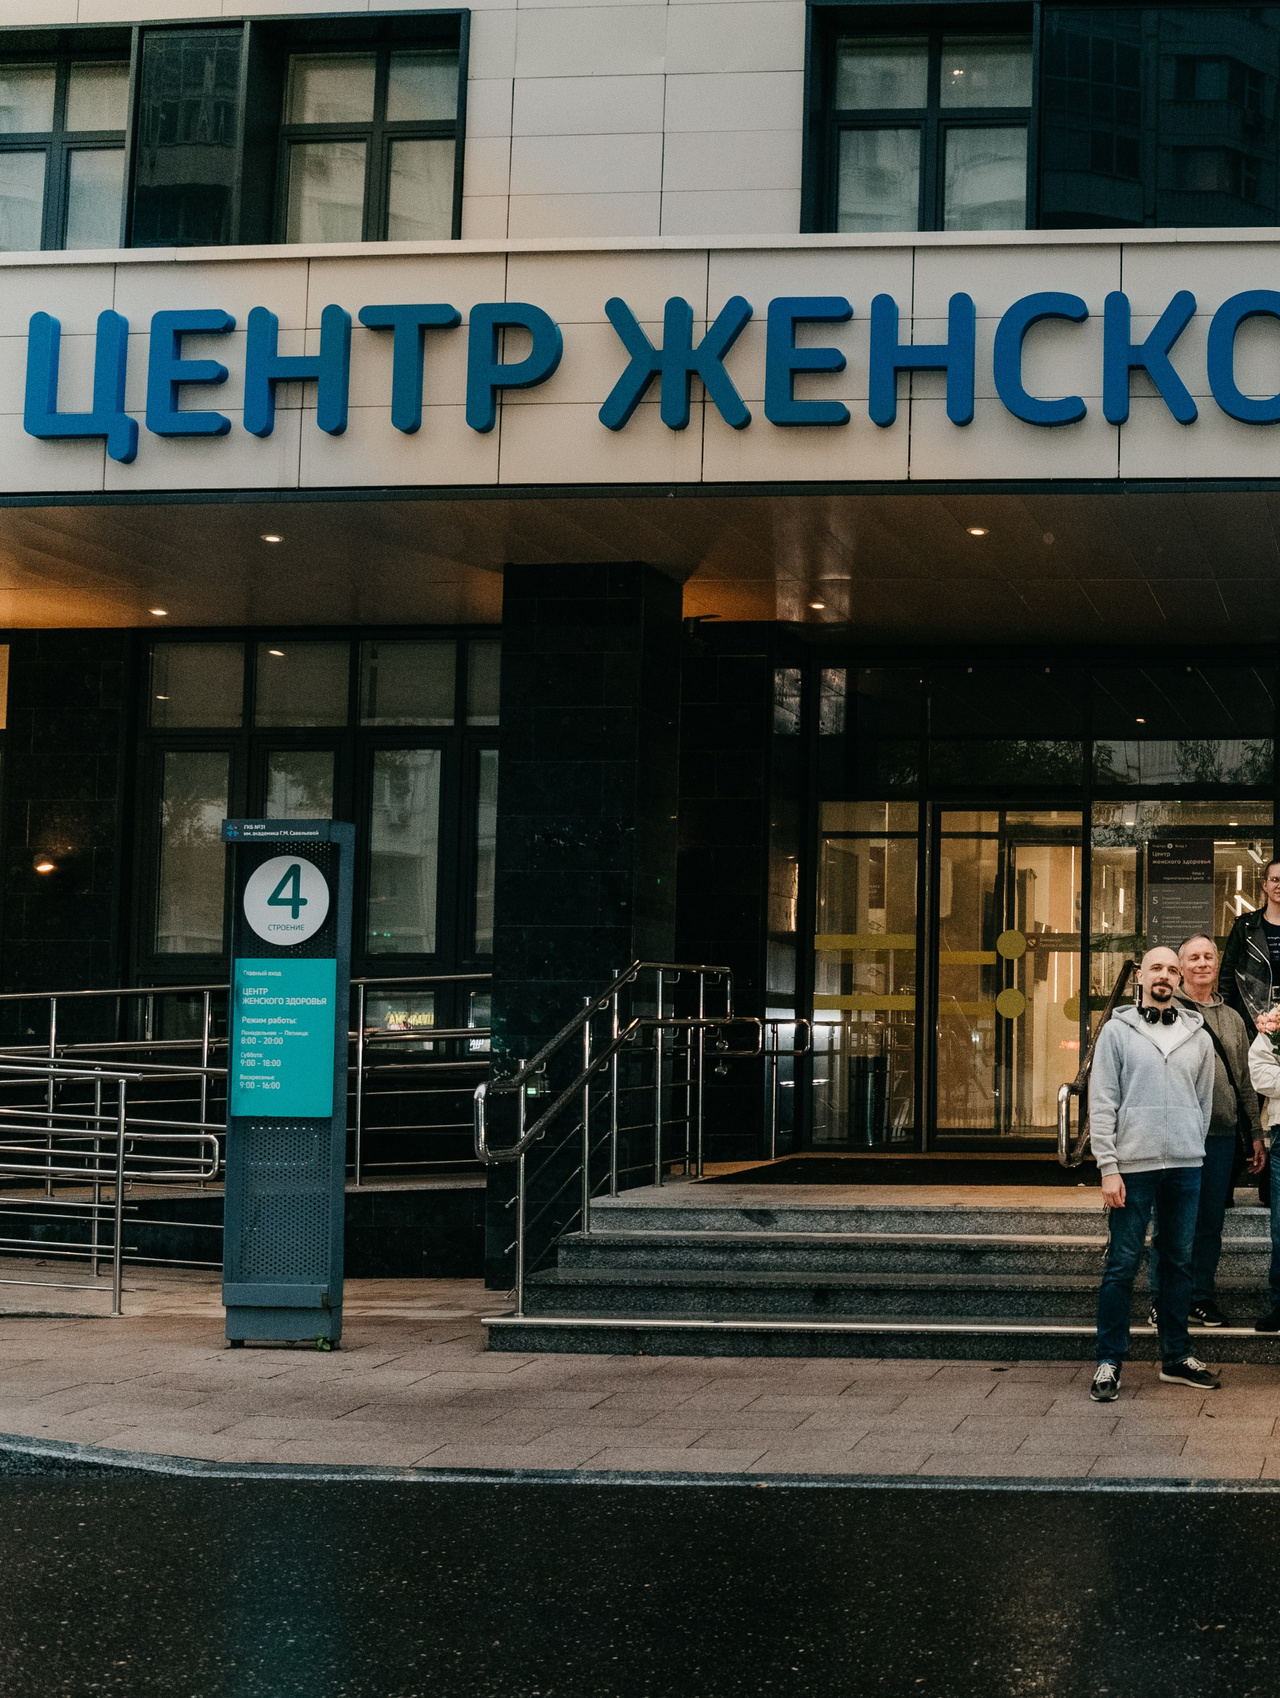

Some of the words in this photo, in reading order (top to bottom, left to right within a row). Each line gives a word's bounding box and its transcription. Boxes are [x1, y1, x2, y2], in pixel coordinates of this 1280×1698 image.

[23, 303, 564, 464] ЦЕНТР
[267, 863, 308, 920] 4
[1152, 896, 1159, 905] 5
[1151, 915, 1159, 924] 4
[1152, 935, 1158, 943] 3
[242, 987, 269, 996] ЦЕНТР
[242, 997, 284, 1005] ЖЕНСКОГО
[285, 997, 327, 1006] ЗДОРОВЬЯ
[241, 1016, 266, 1024] Режим
[240, 1037, 257, 1045] 8:00
[263, 1037, 284, 1045] 20:00
[240, 1059, 256, 1067] 9:00
[262, 1059, 282, 1067] 18:00
[239, 1081, 256, 1089] 9:00
[262, 1081, 281, 1089] 16:00
